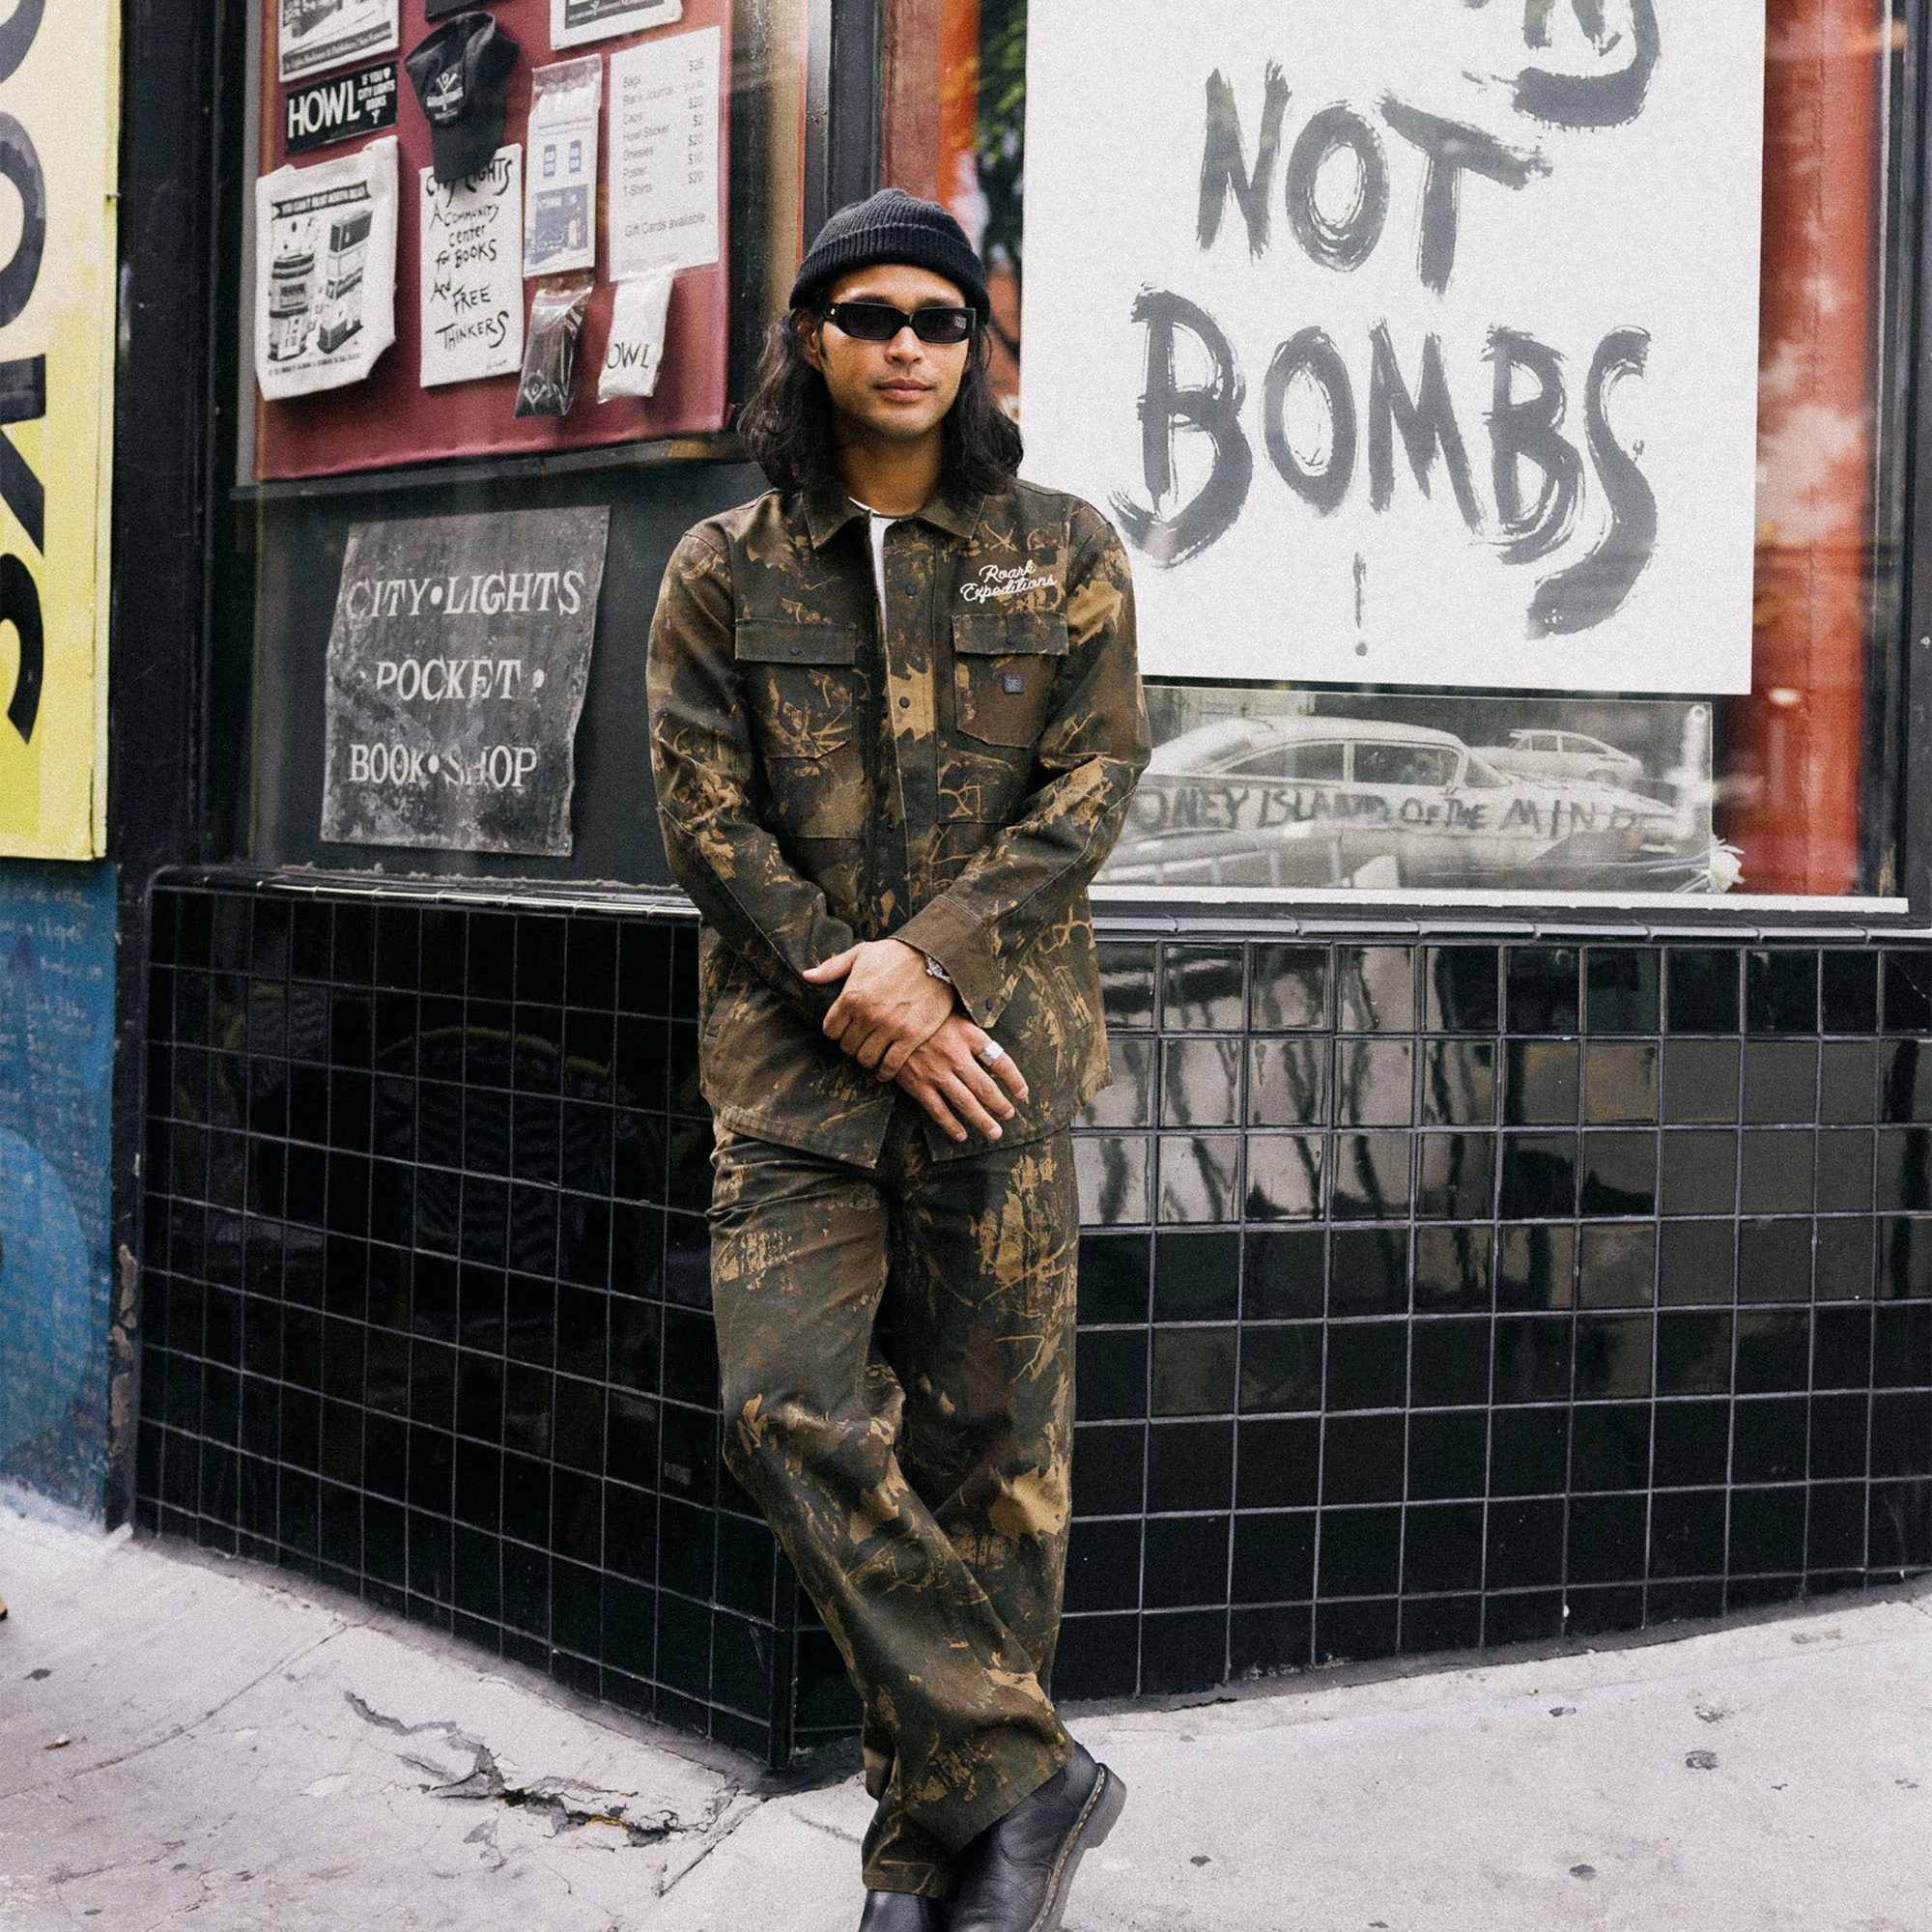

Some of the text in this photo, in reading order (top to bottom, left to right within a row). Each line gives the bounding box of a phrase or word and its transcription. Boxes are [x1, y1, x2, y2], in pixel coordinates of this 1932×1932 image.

[288, 80, 360, 138] HOWL
[1196, 58, 1553, 296] NOT
[429, 200, 443, 231] A
[641, 220, 667, 234] Cards
[668, 212, 706, 230] available
[455, 239, 497, 269] BOOKS
[452, 283, 491, 316] FREE
[435, 310, 509, 351] THINKERS
[1108, 282, 1661, 639] BOMBS
[979, 559, 1037, 583] Roark
[960, 575, 1058, 604] Expeditions
[376, 653, 522, 704] POCKET
